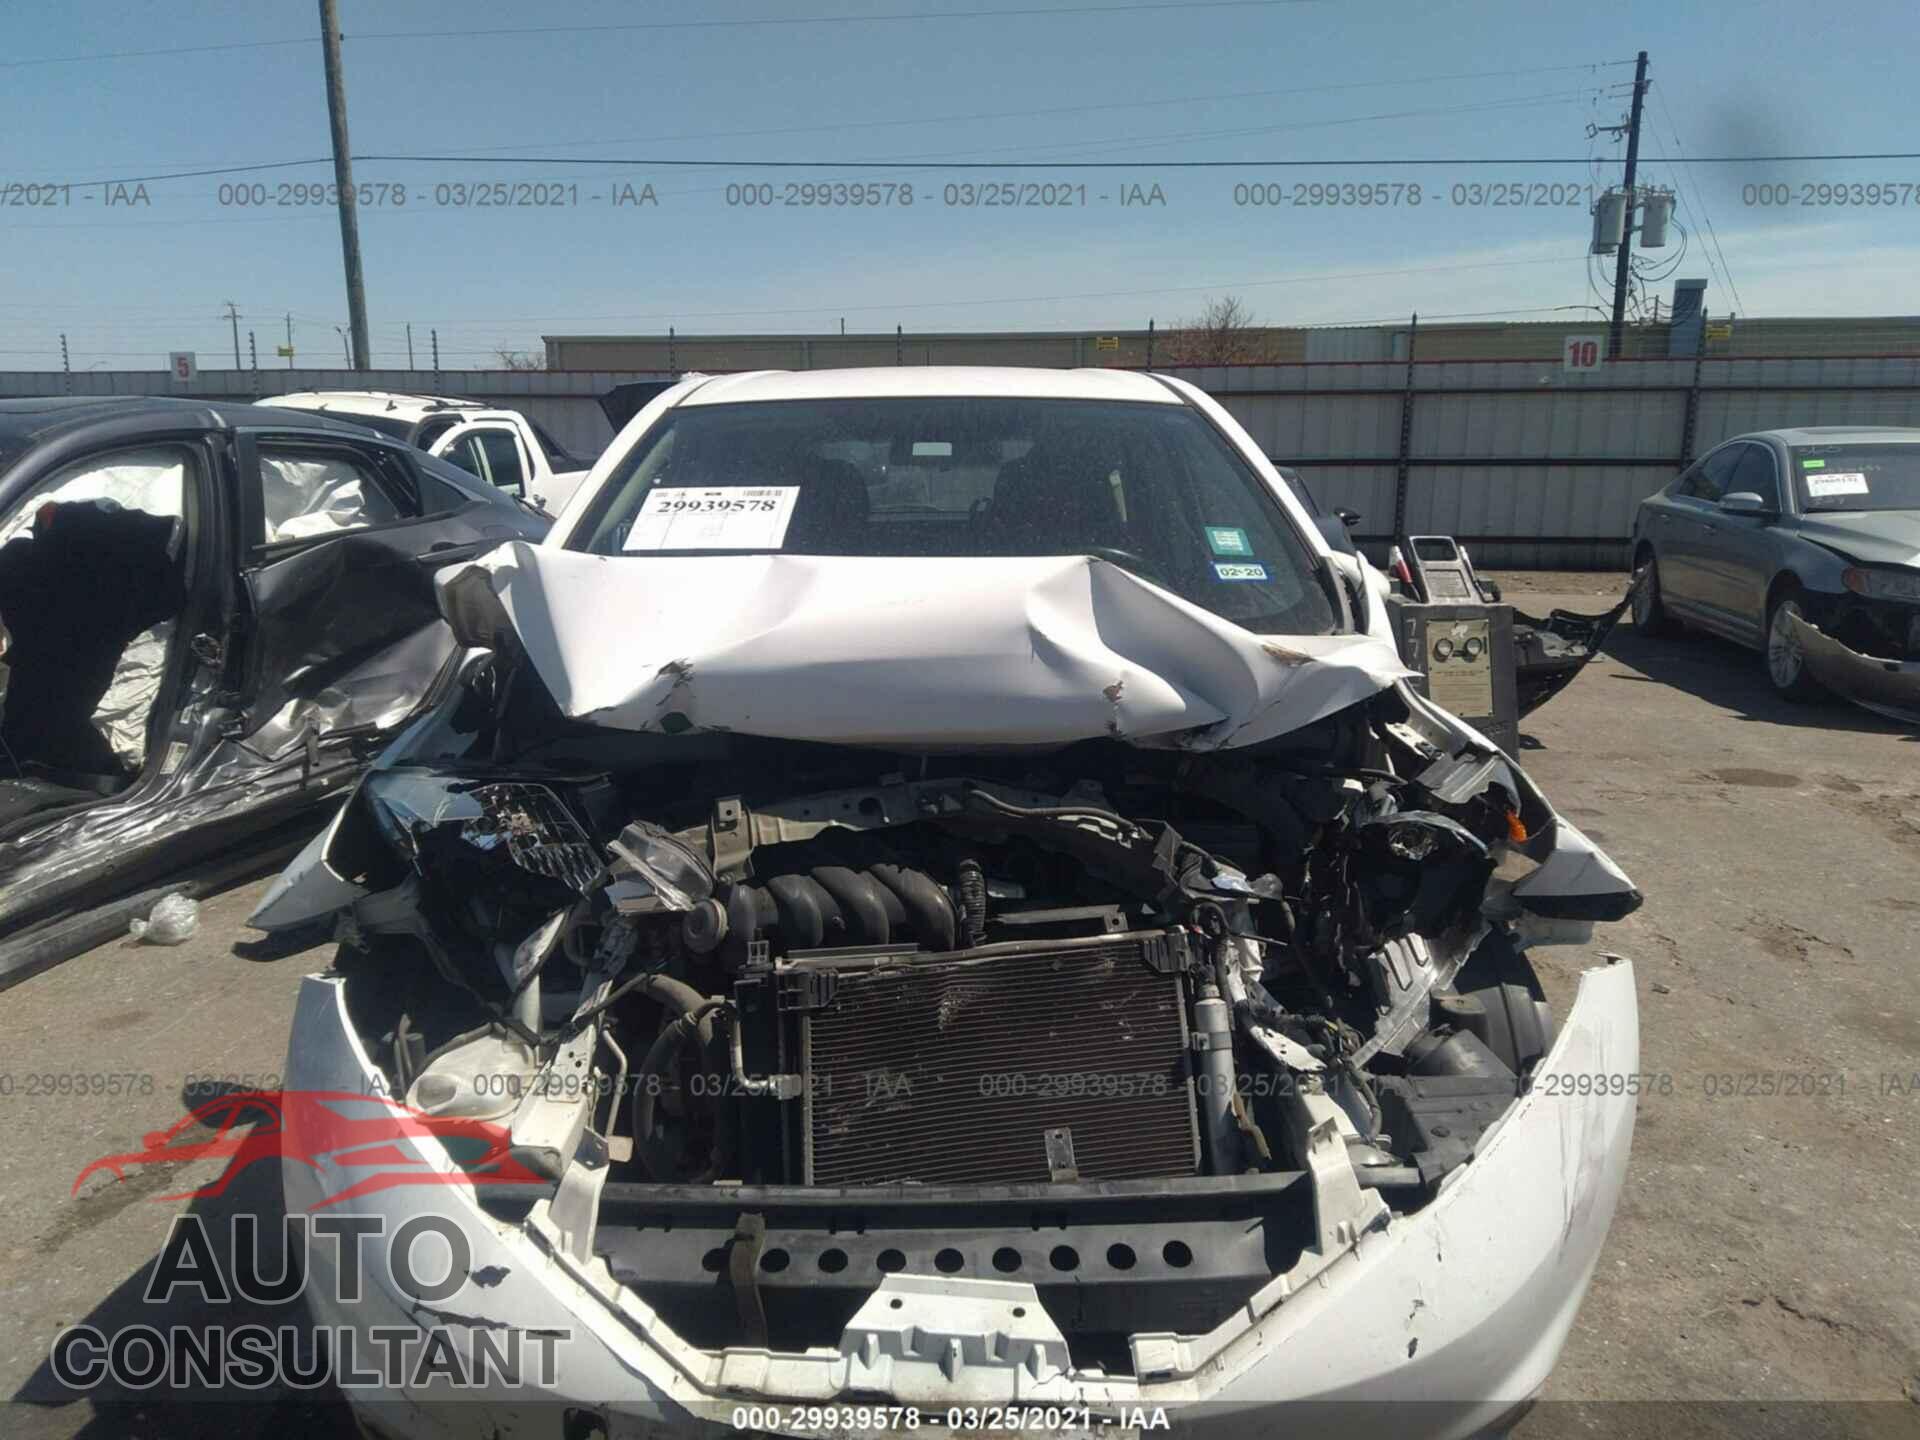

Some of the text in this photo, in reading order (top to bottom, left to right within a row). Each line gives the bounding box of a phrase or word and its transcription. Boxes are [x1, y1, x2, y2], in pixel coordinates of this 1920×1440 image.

[1568, 341, 1598, 367] 10
[177, 357, 189, 378] 5
[657, 500, 776, 513] 29939578
[1220, 567, 1263, 576] 02-20
